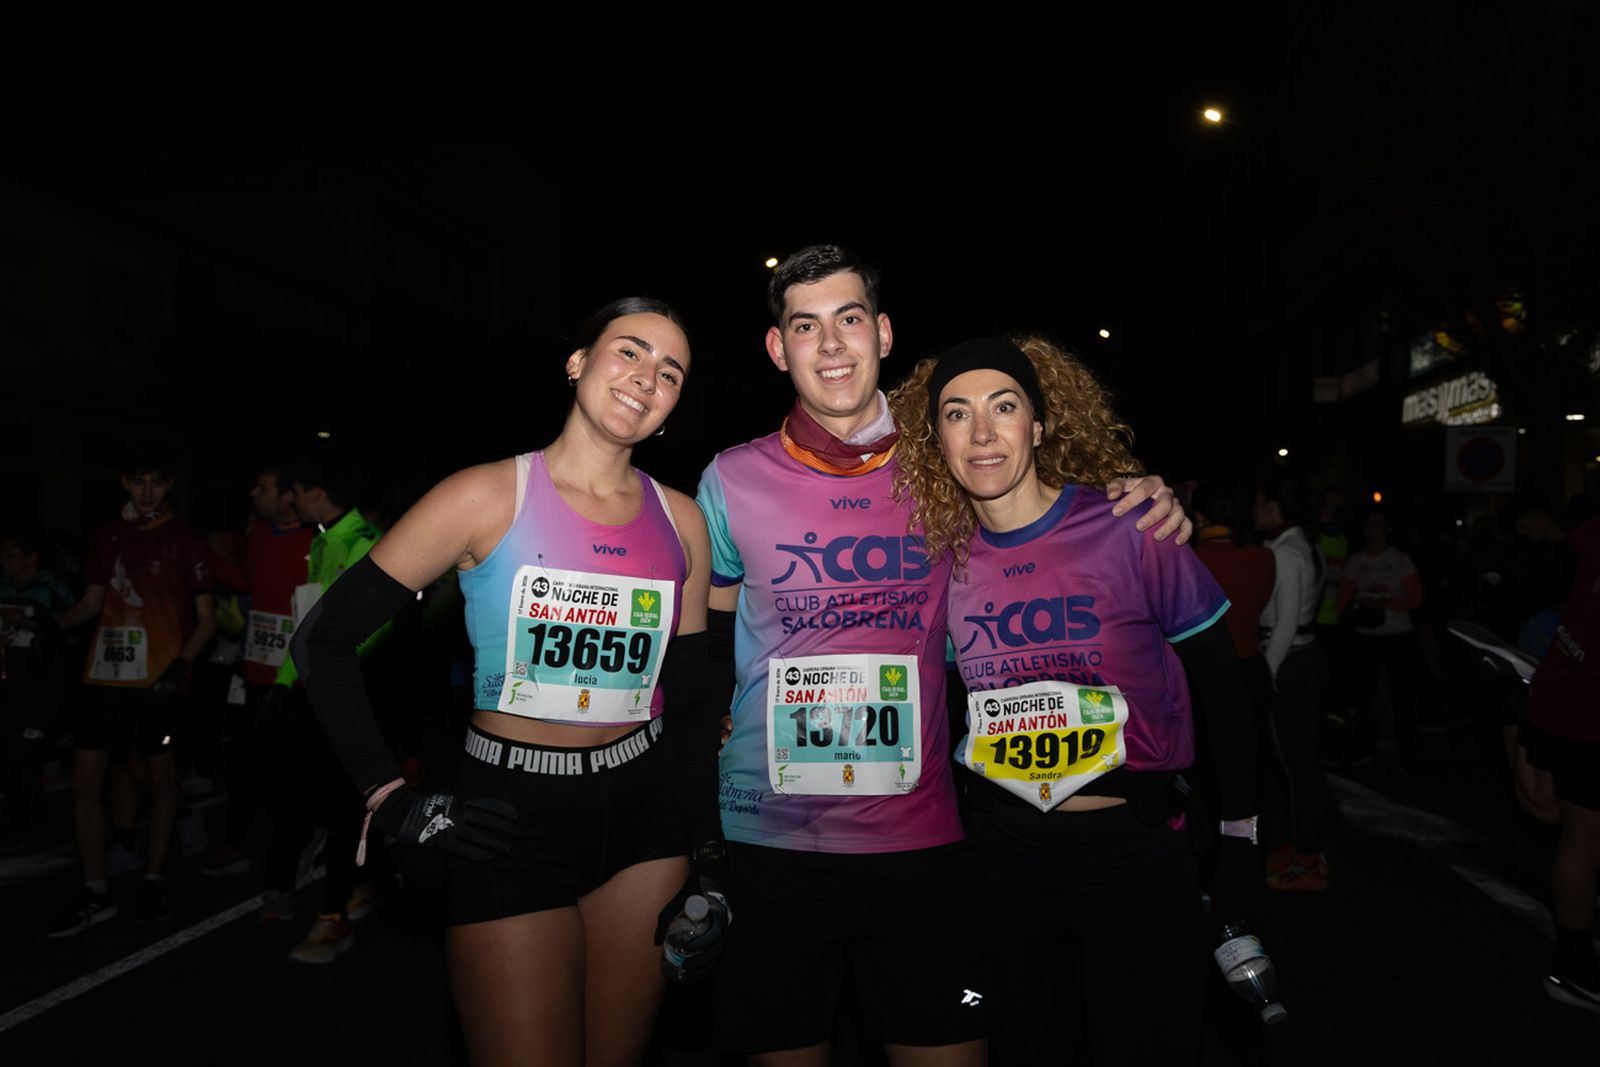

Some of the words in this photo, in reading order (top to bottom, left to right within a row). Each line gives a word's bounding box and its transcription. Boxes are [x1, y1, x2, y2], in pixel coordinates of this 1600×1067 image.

[831, 496, 872, 510] vive
[592, 544, 628, 556] vive
[1003, 562, 1036, 578] vive
[532, 581, 549, 593] 43
[551, 587, 599, 605] NOCHE
[601, 592, 619, 607] DE
[775, 595, 820, 612] CLUB
[826, 591, 929, 607] ATLETISMO
[529, 602, 562, 620] SAN
[565, 606, 618, 625] ANTÓN
[781, 606, 926, 635] SALOBREÑA
[997, 595, 1101, 647] cas
[528, 623, 653, 674] 13659
[786, 670, 800, 682] 43
[963, 662, 996, 681] CLUB
[1000, 651, 1103, 674] ATLETISMO
[803, 672, 847, 686] NOCHE
[785, 689, 815, 703] SAN
[1003, 698, 1045, 716] NOCHE
[1048, 696, 1064, 711] DE
[985, 703, 1000, 713] 43
[790, 705, 899, 747] 13720
[987, 717, 1015, 736] SAN
[1018, 710, 1068, 733] ANTÓN
[465, 726, 503, 766] UMA
[507, 746, 583, 775] PUMA
[590, 730, 650, 773] PUMA
[834, 751, 862, 761] mario
[990, 728, 1105, 770] 13919
[1029, 771, 1063, 781] Sandra
